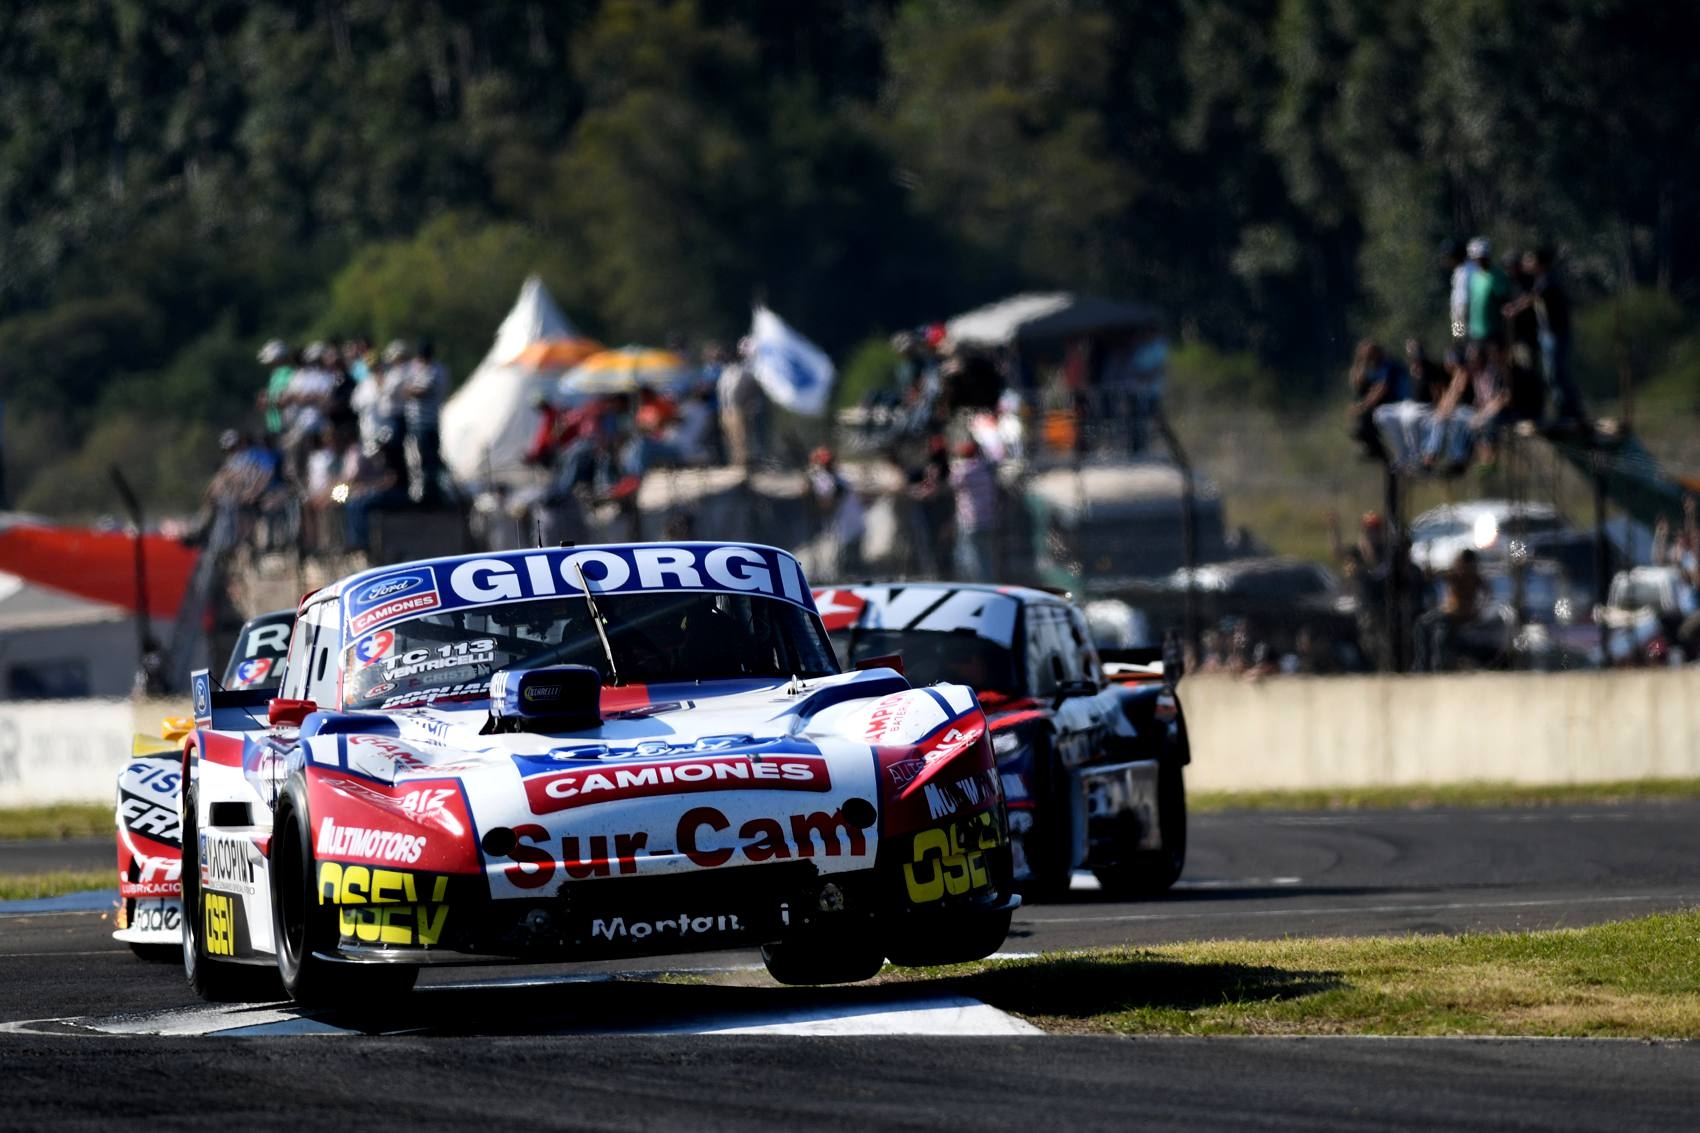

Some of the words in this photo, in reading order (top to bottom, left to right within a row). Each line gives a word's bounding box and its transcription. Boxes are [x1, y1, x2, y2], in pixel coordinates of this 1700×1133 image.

[369, 579, 409, 600] Ford
[450, 546, 804, 605] GIORGI
[357, 596, 434, 628] CAMIONES
[382, 650, 430, 671] TC
[438, 640, 494, 659] 113
[383, 652, 494, 681] VENTRICELLI
[545, 762, 815, 799] CAMIONES
[317, 817, 427, 864] MULTIMOTORS
[504, 806, 867, 889] Sur-Cam
[205, 892, 234, 956] OSEV
